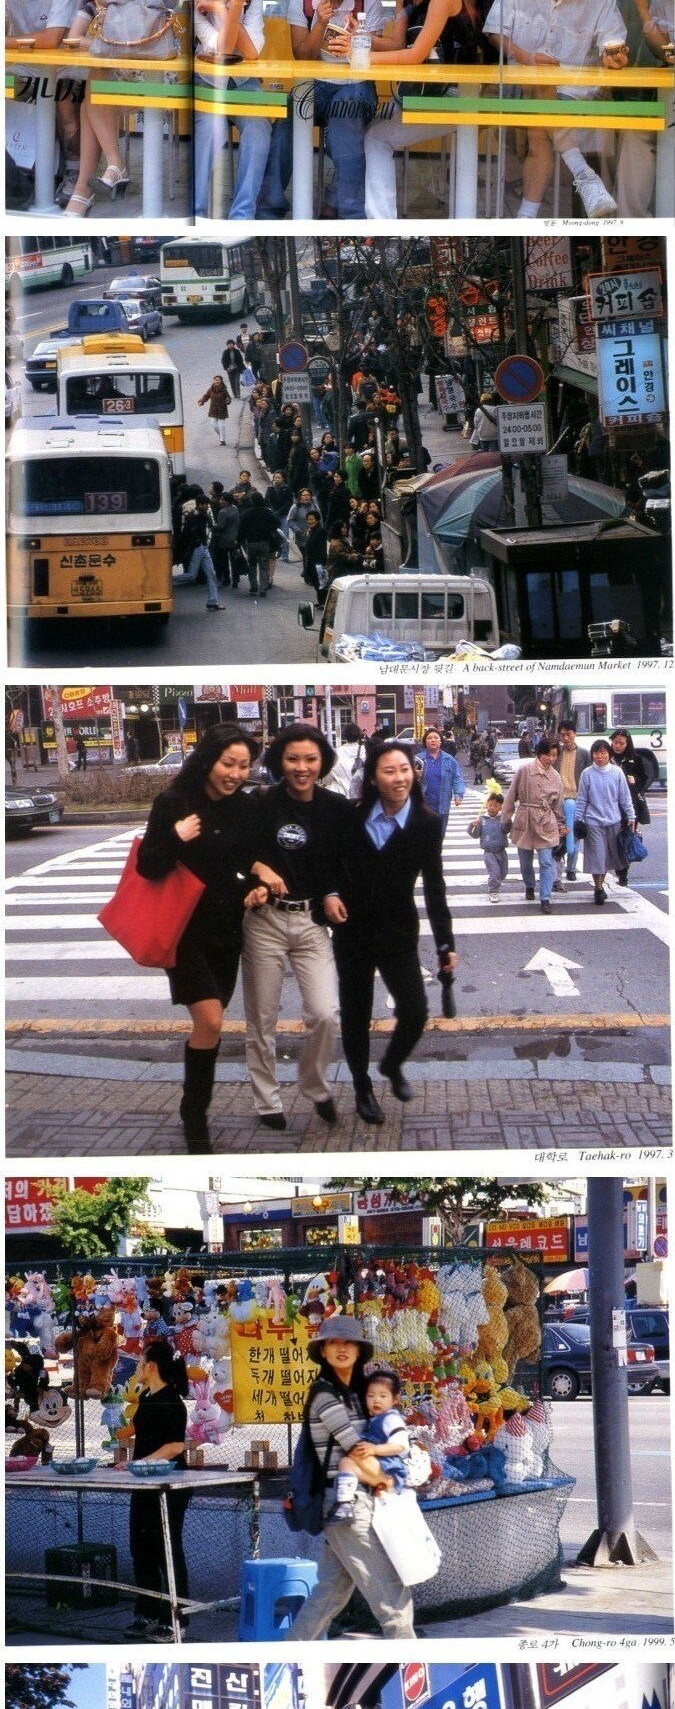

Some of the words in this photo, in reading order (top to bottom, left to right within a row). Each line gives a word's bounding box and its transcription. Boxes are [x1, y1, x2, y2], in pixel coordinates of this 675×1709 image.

[528, 252, 569, 268] Coffee
[527, 274, 567, 289] Drink
[601, 319, 654, 337] 씨채널
[613, 340, 640, 413] 그레이스
[643, 370, 655, 393] 안경
[105, 398, 132, 412] 26-3
[502, 424, 542, 434] 24:00-05:00
[503, 437, 526, 447] 일요일
[87, 493, 123, 511] 139
[60, 553, 117, 568] 신촌운수
[163, 687, 194, 699] Pizza
[650, 731, 662, 749] 3
[248, 1346, 275, 1364] 한개
[251, 1389, 277, 1406] 세개
[404, 1666, 426, 1690] KINO
